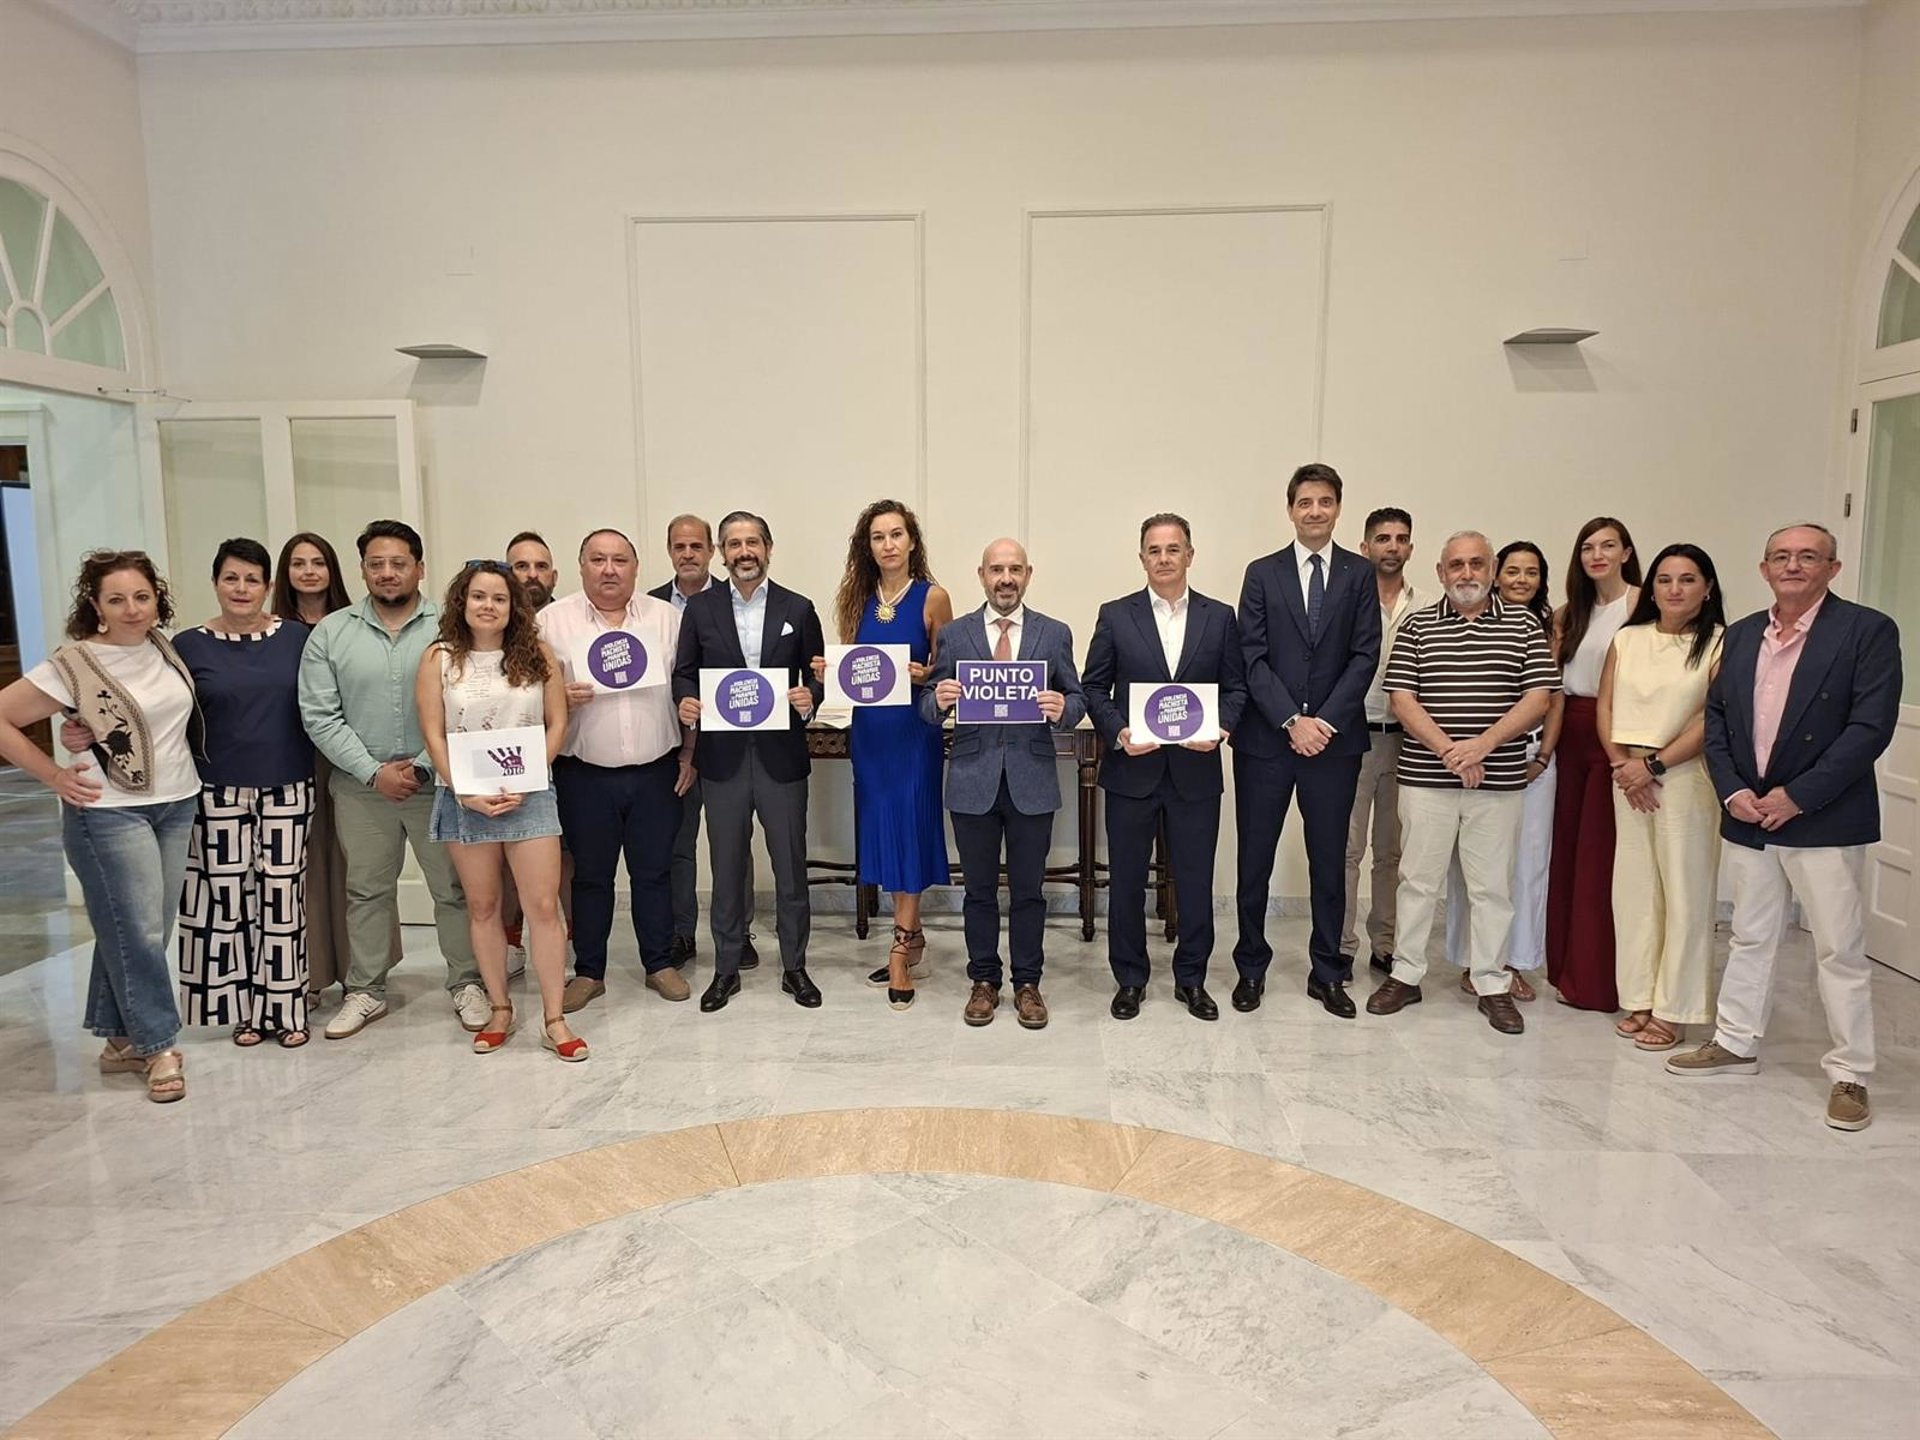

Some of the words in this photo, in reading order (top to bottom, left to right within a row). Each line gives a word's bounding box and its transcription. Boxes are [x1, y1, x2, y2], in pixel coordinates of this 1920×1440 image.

[602, 654, 632, 672] UNIDAS
[851, 671, 880, 685] UNIDAS
[970, 668, 1034, 683] PUNTO
[962, 685, 1038, 700] VIOLETA
[729, 695, 759, 709] UNIDAS
[1158, 710, 1188, 724] UNIDAS
